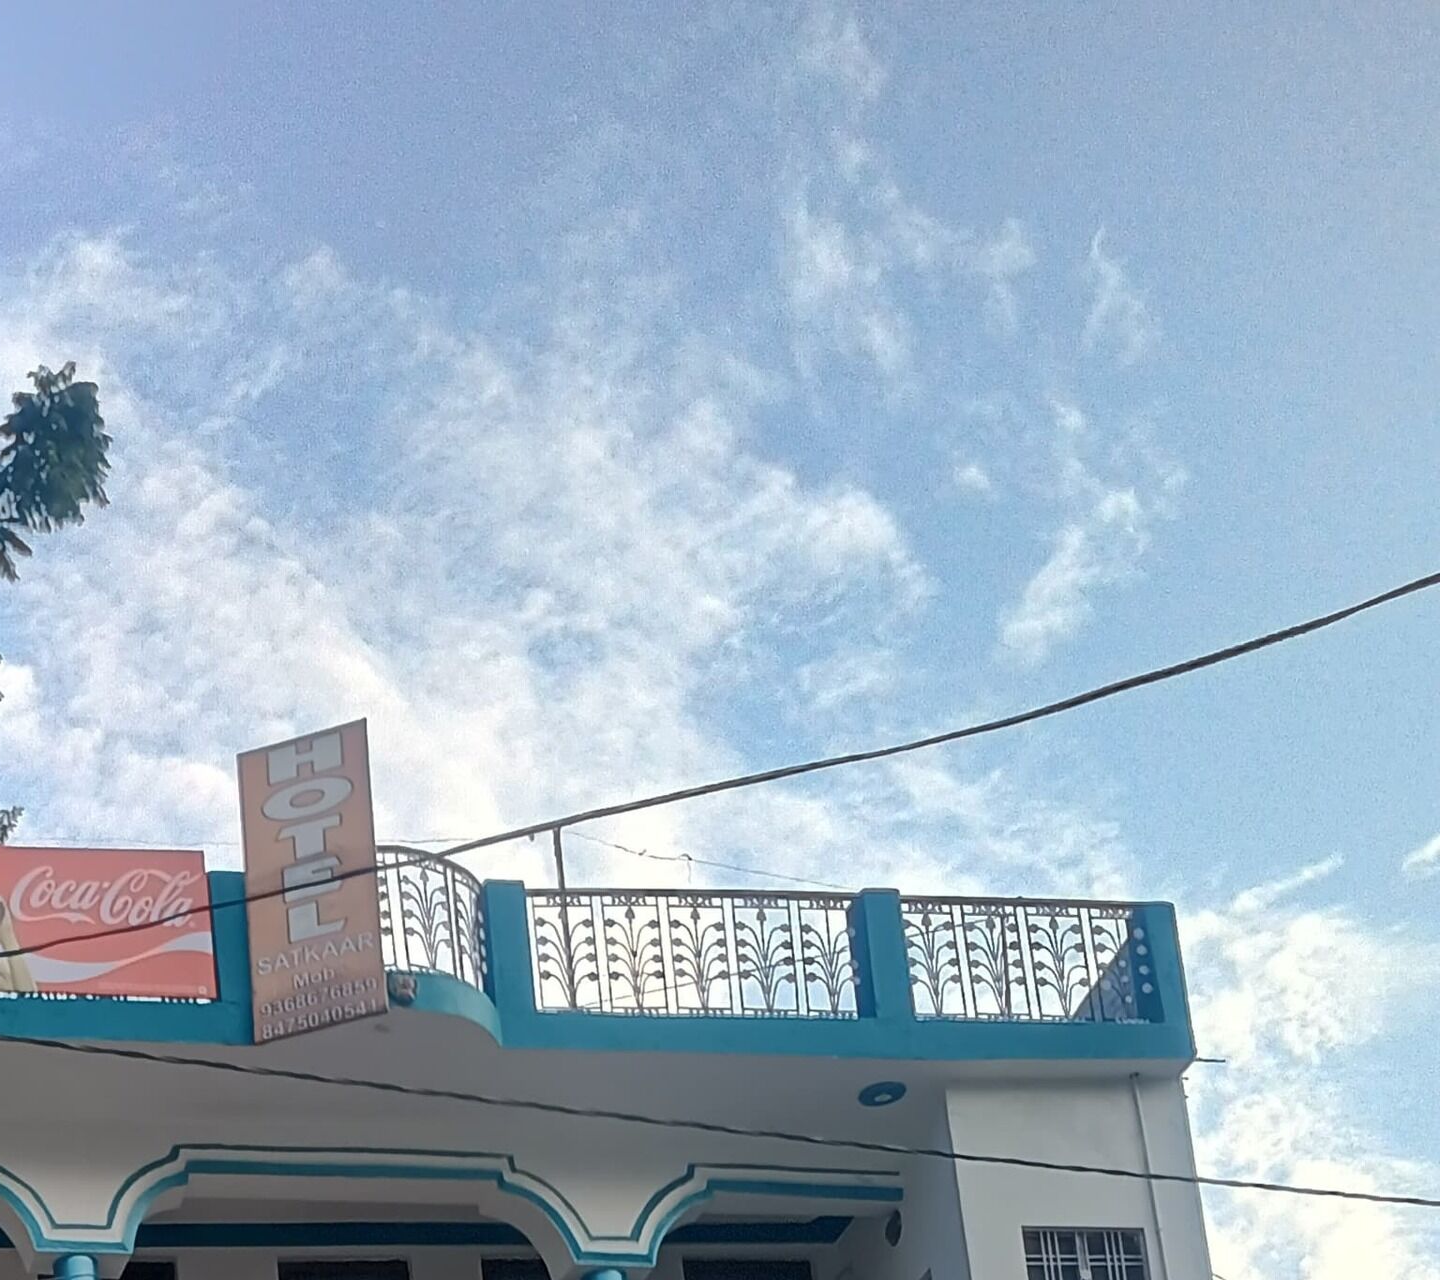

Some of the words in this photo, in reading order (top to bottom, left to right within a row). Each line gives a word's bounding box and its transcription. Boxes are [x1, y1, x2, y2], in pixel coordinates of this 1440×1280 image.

[259, 730, 354, 944] HOTEL
[10, 865, 202, 928] Coca-Cola
[257, 930, 373, 976] SATKAAR
[292, 967, 335, 990] Mob
